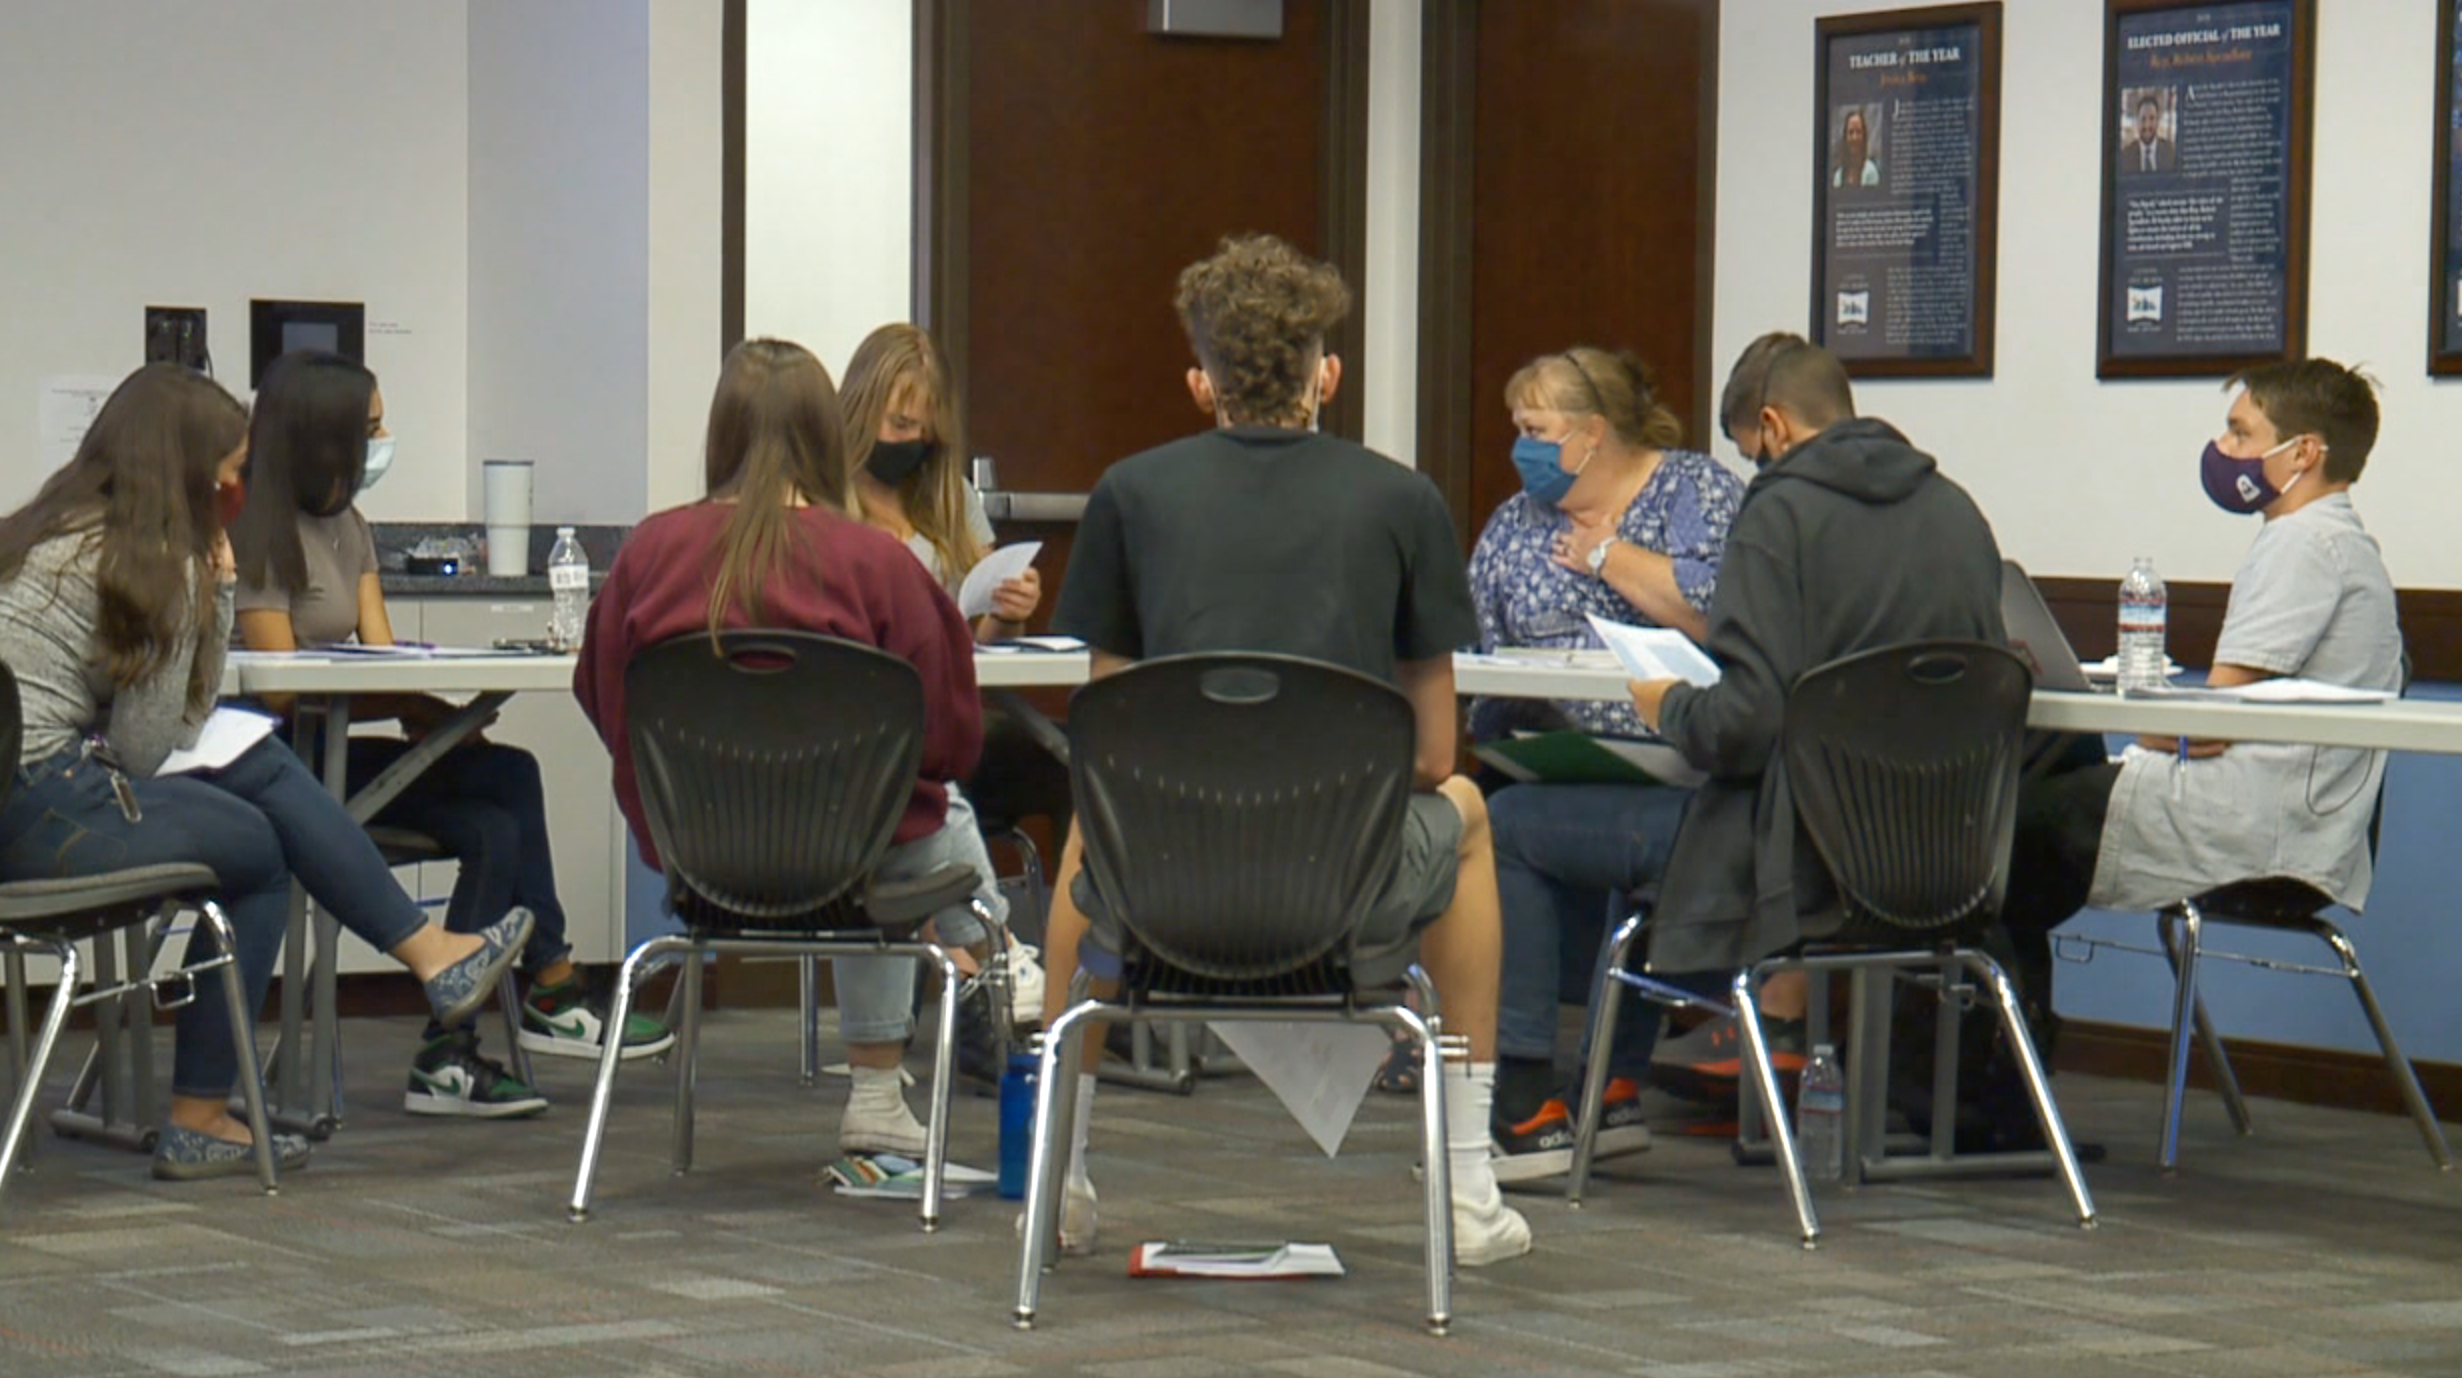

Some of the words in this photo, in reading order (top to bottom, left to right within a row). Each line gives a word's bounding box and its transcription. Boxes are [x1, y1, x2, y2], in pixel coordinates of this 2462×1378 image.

[2127, 33, 2173, 49] ELECTED
[2174, 30, 2219, 45] OFFICIAL
[2231, 27, 2252, 40] THE
[2253, 23, 2280, 37] YEAR
[1850, 52, 1897, 69] TEACHER
[1909, 49, 1930, 64] THE
[1932, 47, 1960, 62] YEAR
